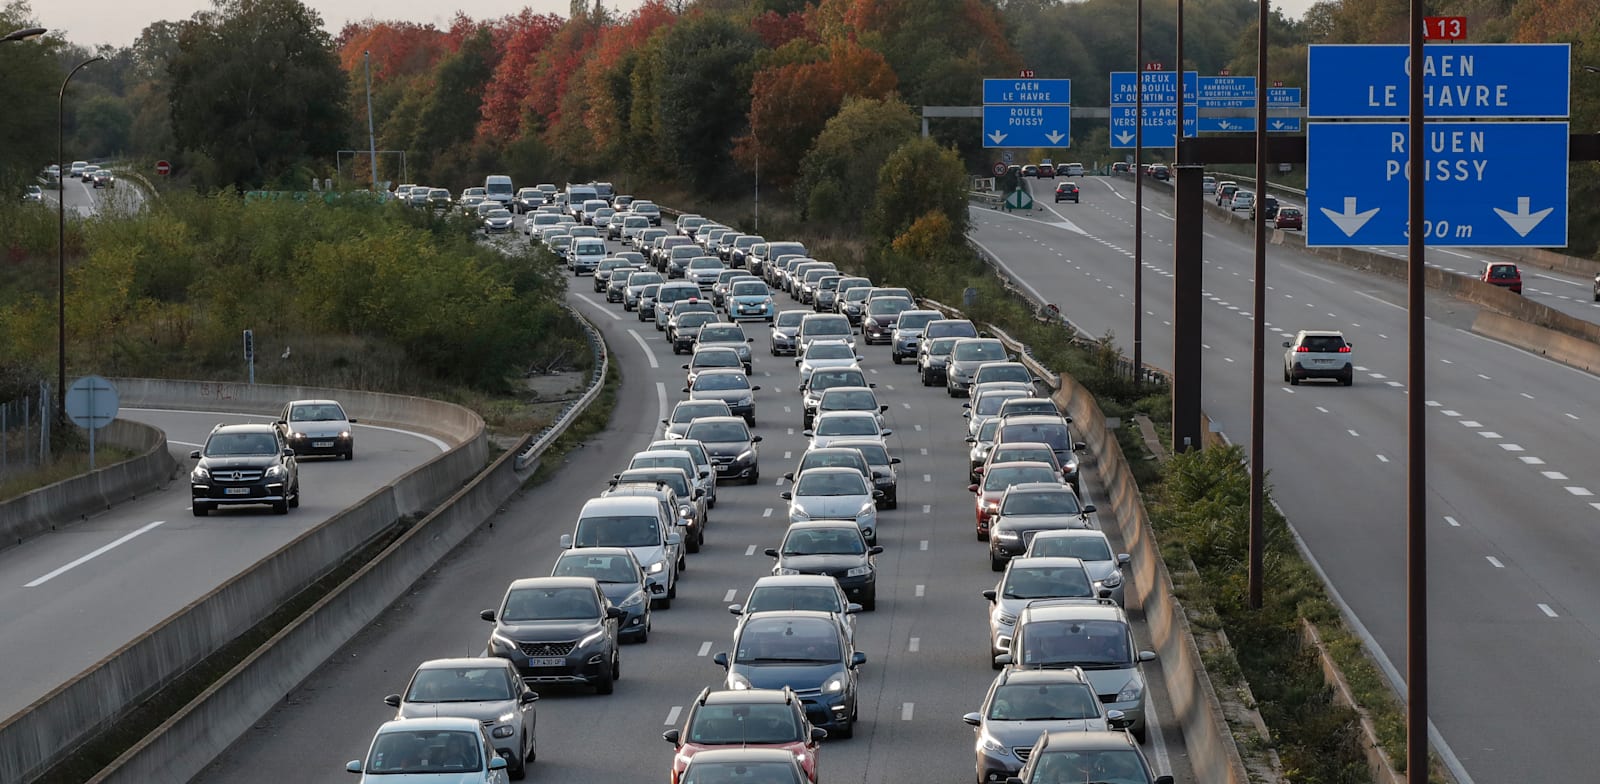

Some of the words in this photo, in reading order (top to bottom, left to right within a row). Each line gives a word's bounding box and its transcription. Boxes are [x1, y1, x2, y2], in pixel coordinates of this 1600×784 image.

[1438, 19, 1461, 37] 13
[1141, 74, 1170, 82] REUX
[1014, 82, 1040, 91] CAEN
[1120, 84, 1188, 92] RABOUILLT
[1003, 92, 1014, 101] LE
[1020, 92, 1051, 101] HAVRE
[1126, 93, 1163, 102] QUNTIN
[1369, 85, 1397, 107] LE
[1423, 85, 1509, 107] HAVRE
[1010, 108, 1043, 117] ROUEN
[1124, 108, 1148, 117] BOS
[1152, 108, 1177, 117] D'ARC
[1009, 117, 1044, 126] POISSY
[1391, 131, 1485, 153] RUEN
[1455, 225, 1473, 238] m
